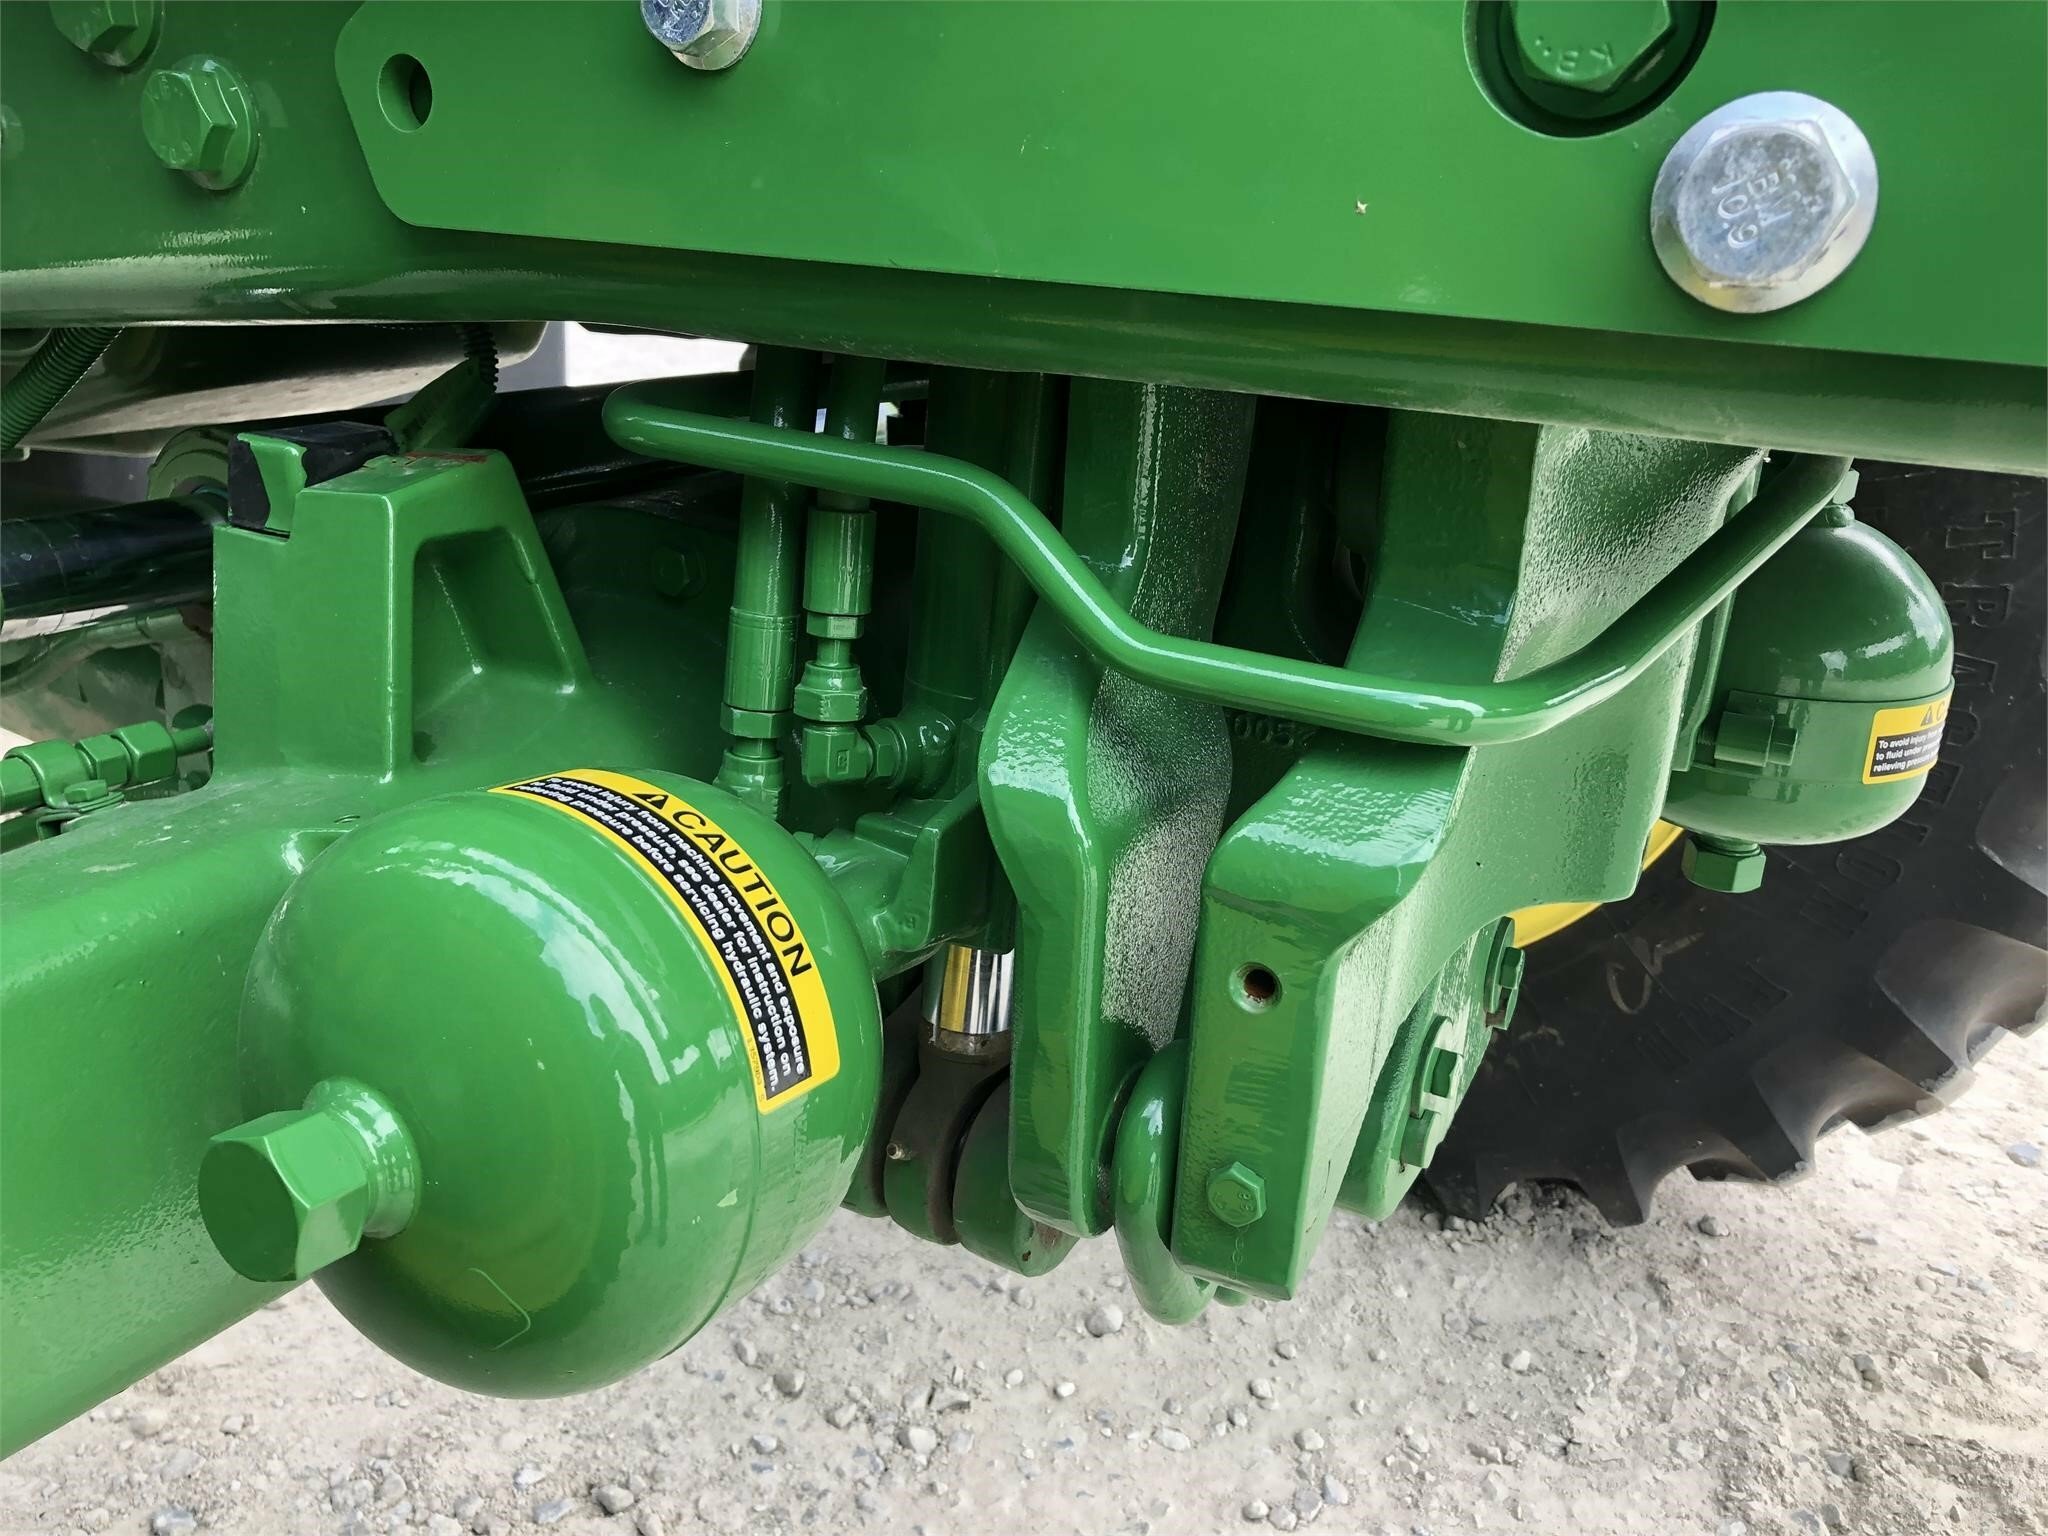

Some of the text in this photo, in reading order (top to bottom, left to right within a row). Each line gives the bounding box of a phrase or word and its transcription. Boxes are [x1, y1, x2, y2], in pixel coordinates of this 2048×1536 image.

[569, 800, 634, 836] pressure
[631, 835, 675, 873] before
[672, 873, 726, 940] servicing
[722, 941, 762, 1020] hydraulic
[757, 1022, 779, 1092] system.
[576, 792, 620, 811] under
[614, 811, 677, 859] pressure,
[677, 859, 703, 882] see
[700, 884, 737, 929] dealer
[733, 930, 752, 954] for
[747, 956, 786, 1049] instruction
[780, 1052, 791, 1077] on
[598, 790, 640, 811] injury
[637, 810, 670, 833] from
[668, 833, 720, 882] machine
[717, 883, 771, 961] movement
[765, 962, 786, 994] and
[779, 995, 806, 1075] exposure
[672, 810, 813, 977] CAUTION
